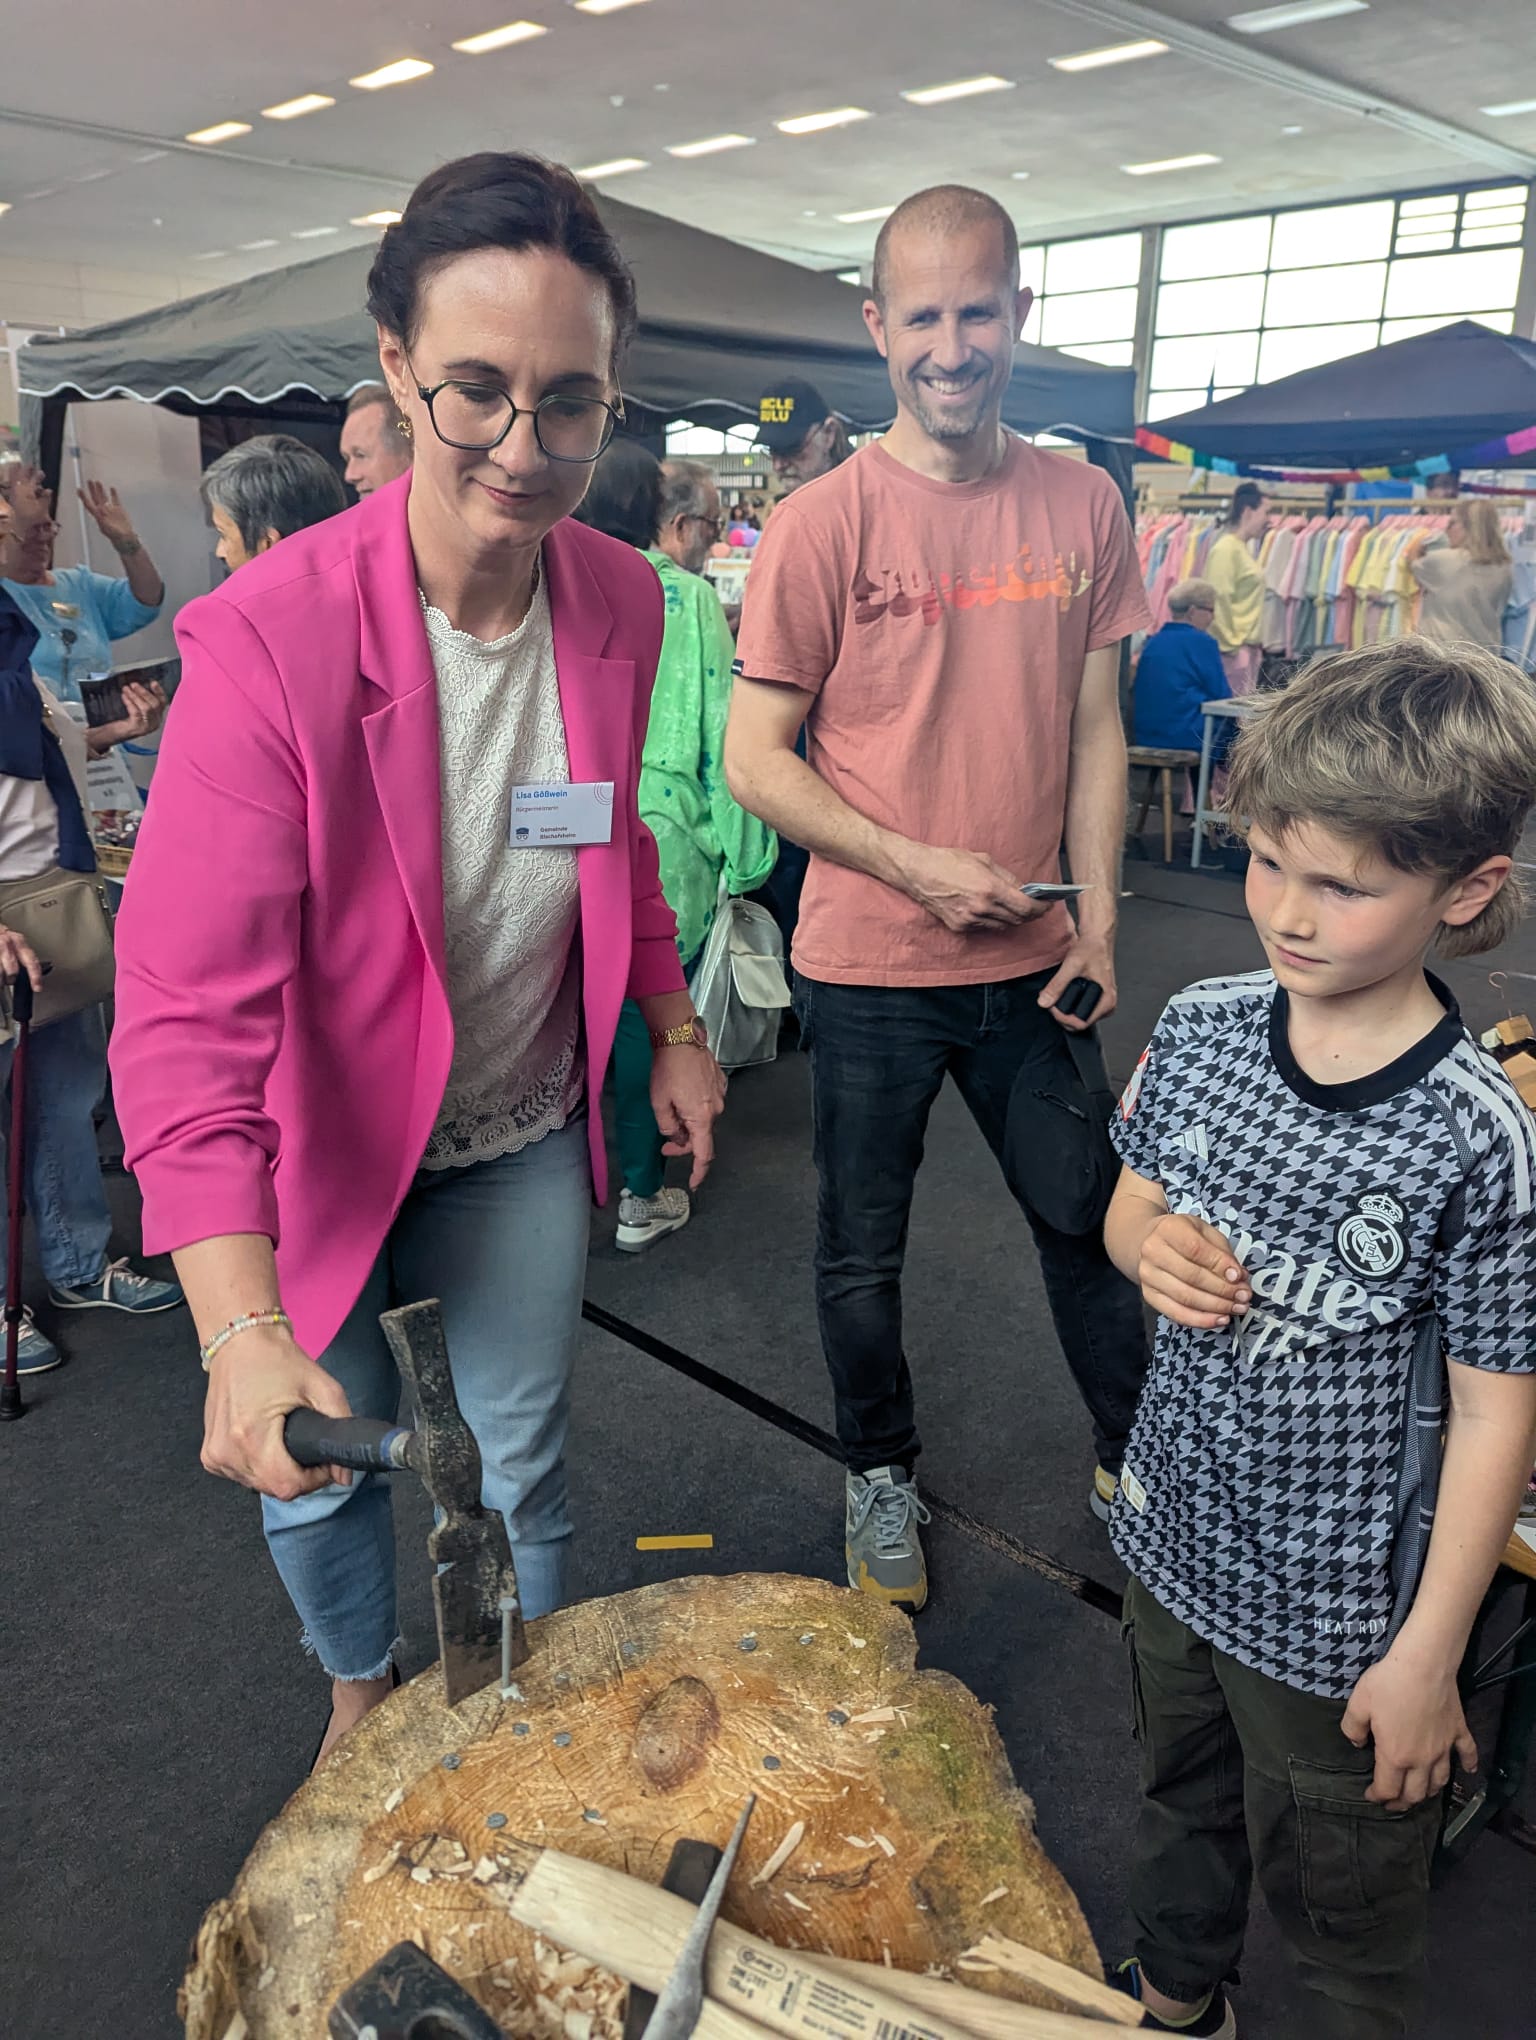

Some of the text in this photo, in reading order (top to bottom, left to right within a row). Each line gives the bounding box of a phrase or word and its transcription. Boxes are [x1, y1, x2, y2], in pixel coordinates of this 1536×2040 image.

[516, 789, 567, 799] Lisa Gößwein
[1313, 1616, 1388, 1635] HEAT RDY
